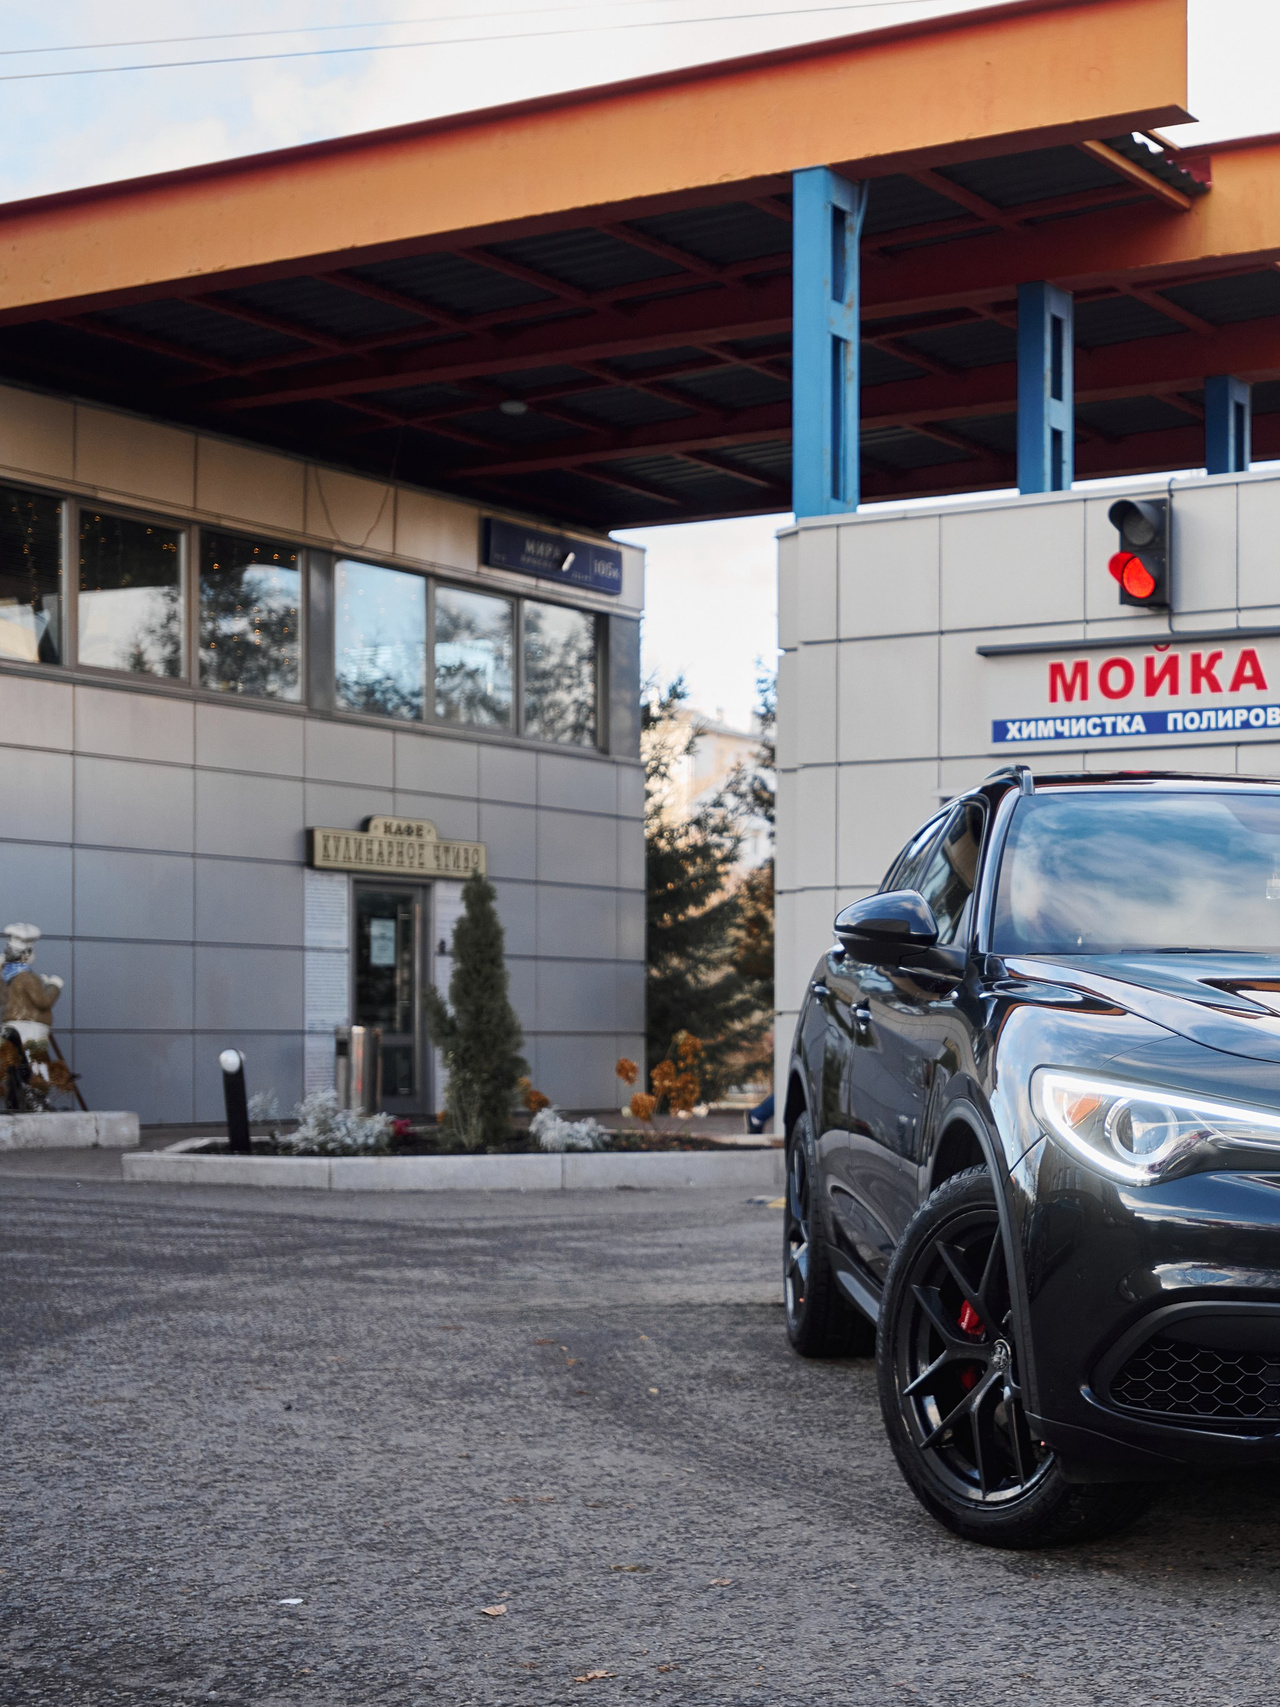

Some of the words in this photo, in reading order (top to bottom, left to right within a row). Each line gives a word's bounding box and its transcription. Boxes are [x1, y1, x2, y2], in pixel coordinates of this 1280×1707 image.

[1048, 643, 1269, 704] МОЙКА
[1005, 714, 1147, 741] ХИМЧИСТКА
[383, 821, 424, 837] КАФЕ
[321, 834, 425, 867] КУЛИНАРНОЕ
[433, 844, 481, 871] ЧТИВО
